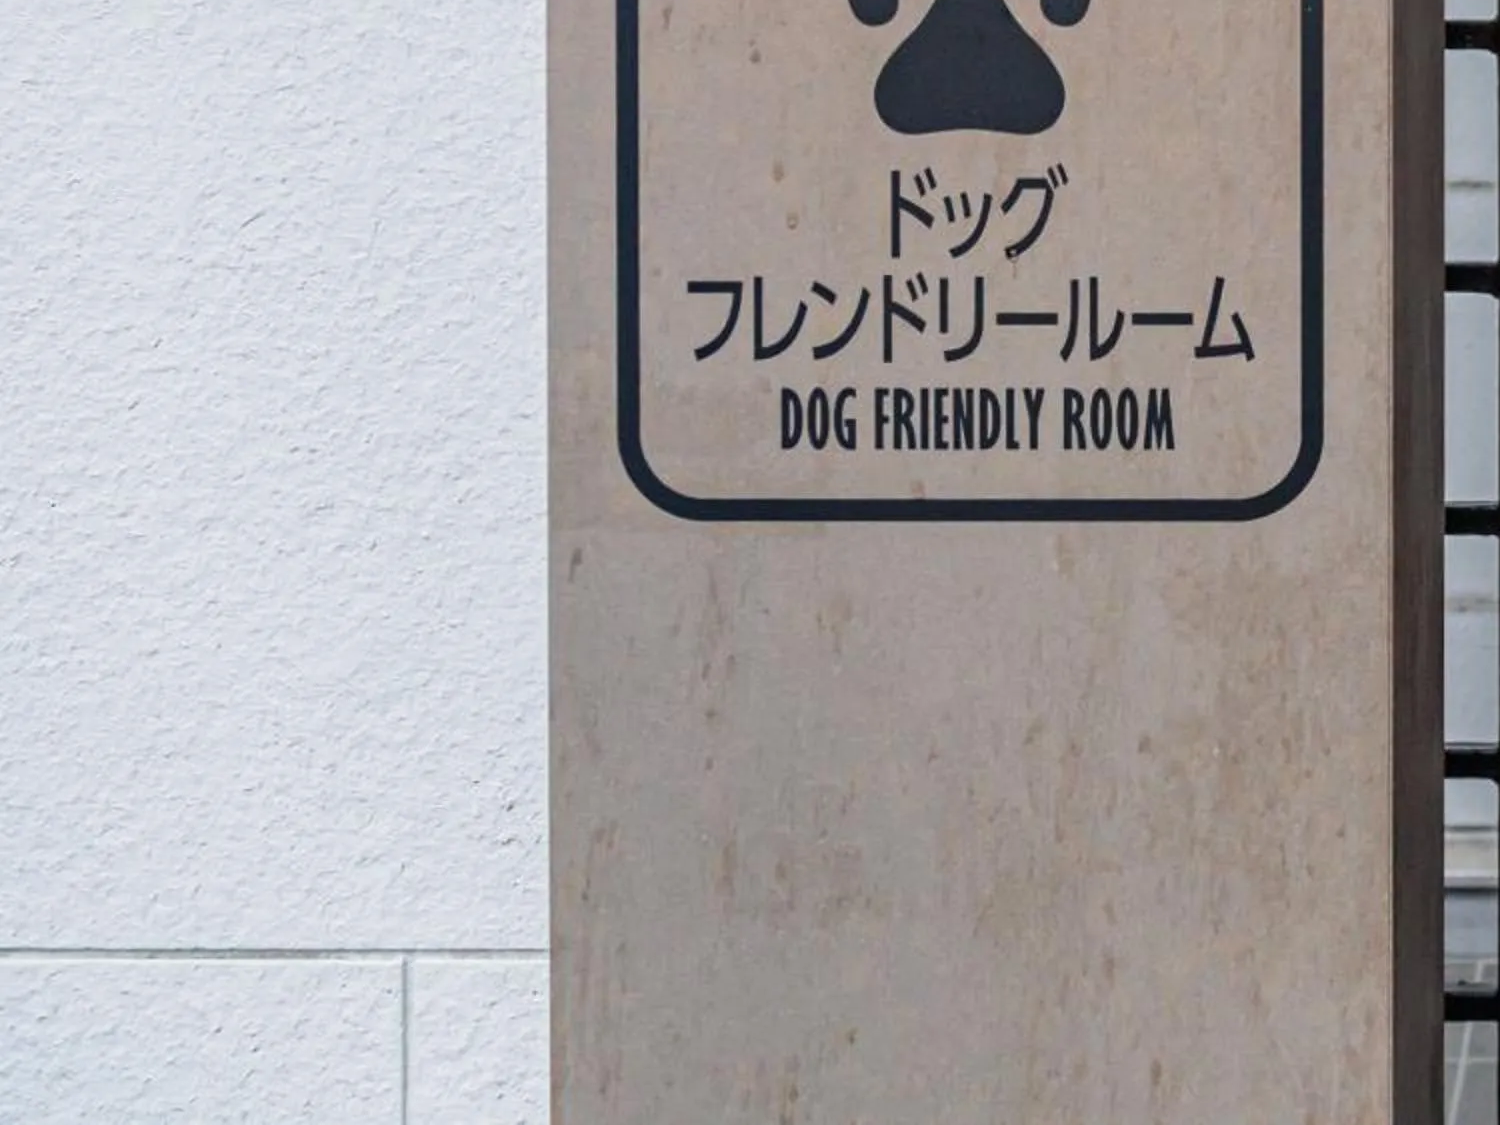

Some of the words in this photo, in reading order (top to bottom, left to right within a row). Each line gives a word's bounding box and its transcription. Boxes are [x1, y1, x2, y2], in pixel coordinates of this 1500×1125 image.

[890, 162, 1068, 259] ドッグ
[686, 272, 1256, 364] フレンドリールーム
[780, 386, 857, 451] DOG
[874, 387, 1046, 451] FRIENDLY
[1063, 386, 1176, 452] ROOM
